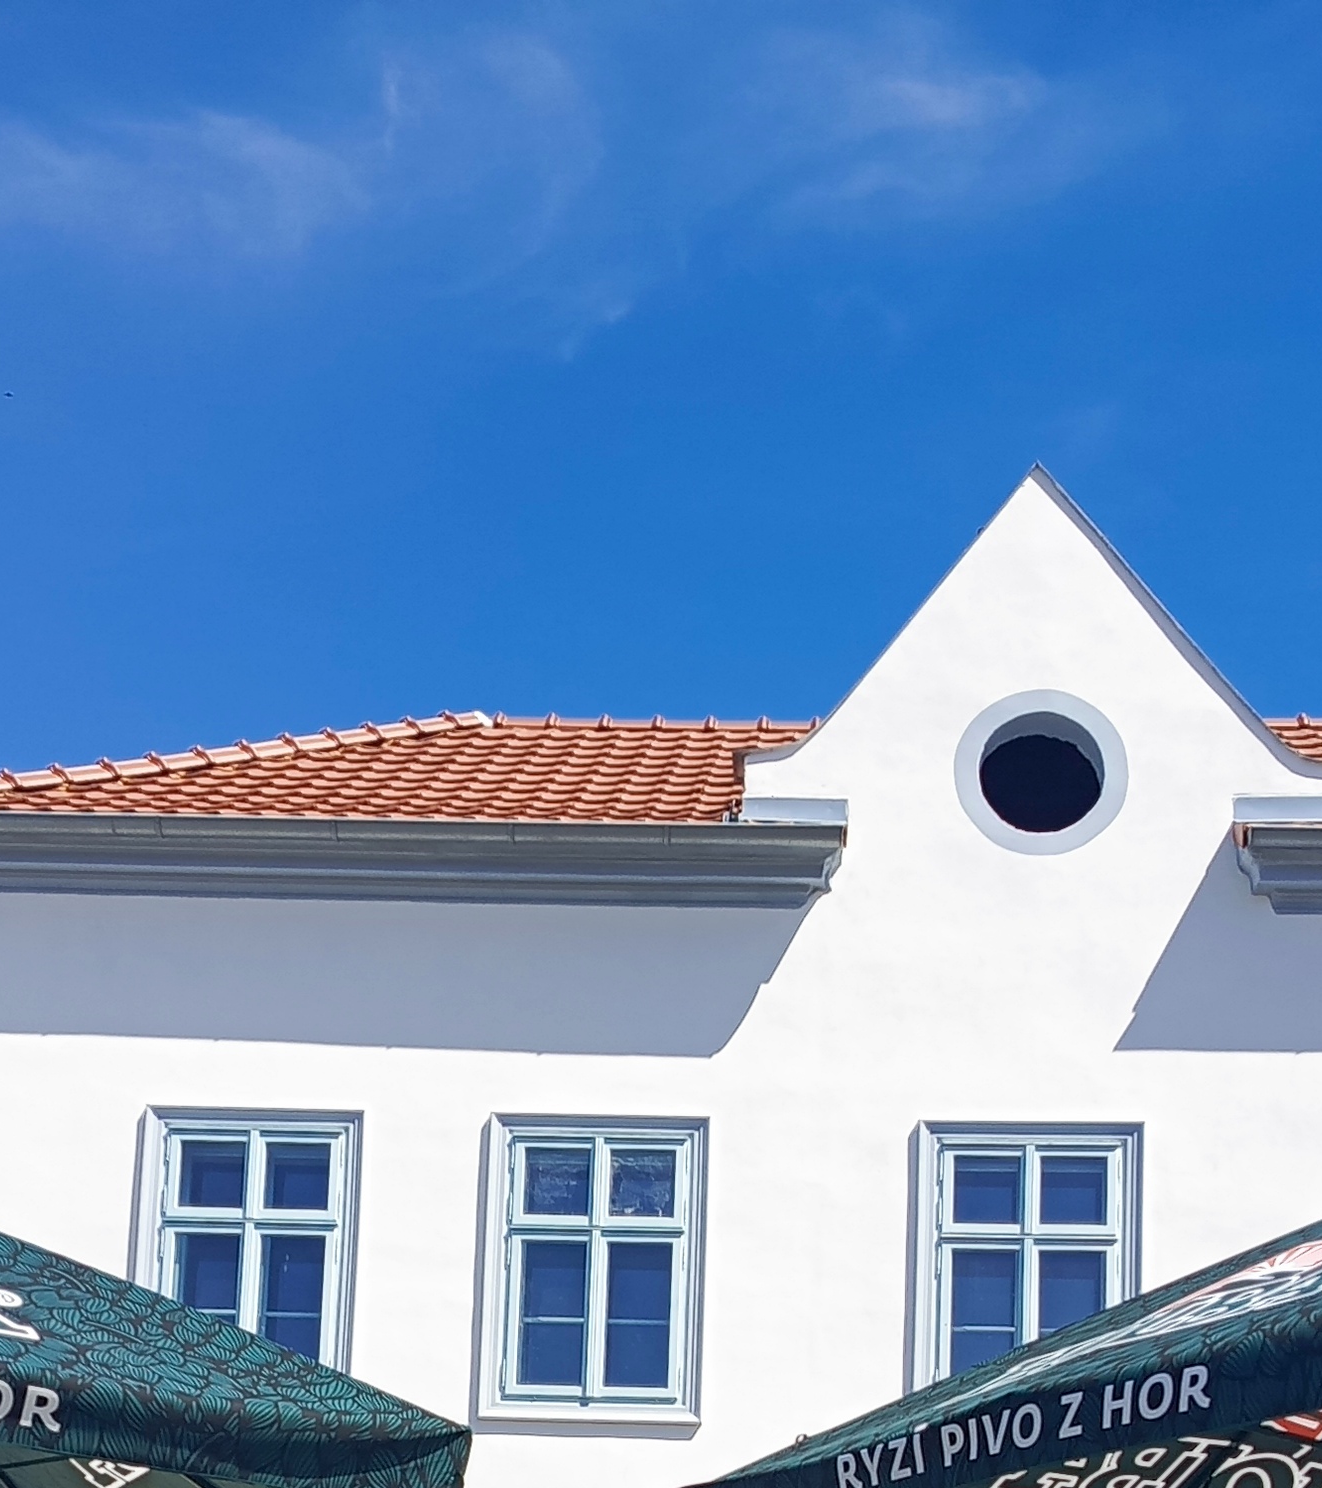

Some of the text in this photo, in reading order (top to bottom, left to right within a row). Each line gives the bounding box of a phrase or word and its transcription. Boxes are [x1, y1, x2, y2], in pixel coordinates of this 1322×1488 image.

[941, 1403, 1042, 1468] PIVO
[1059, 1393, 1084, 1439] Z
[1101, 1364, 1211, 1430] HOR
